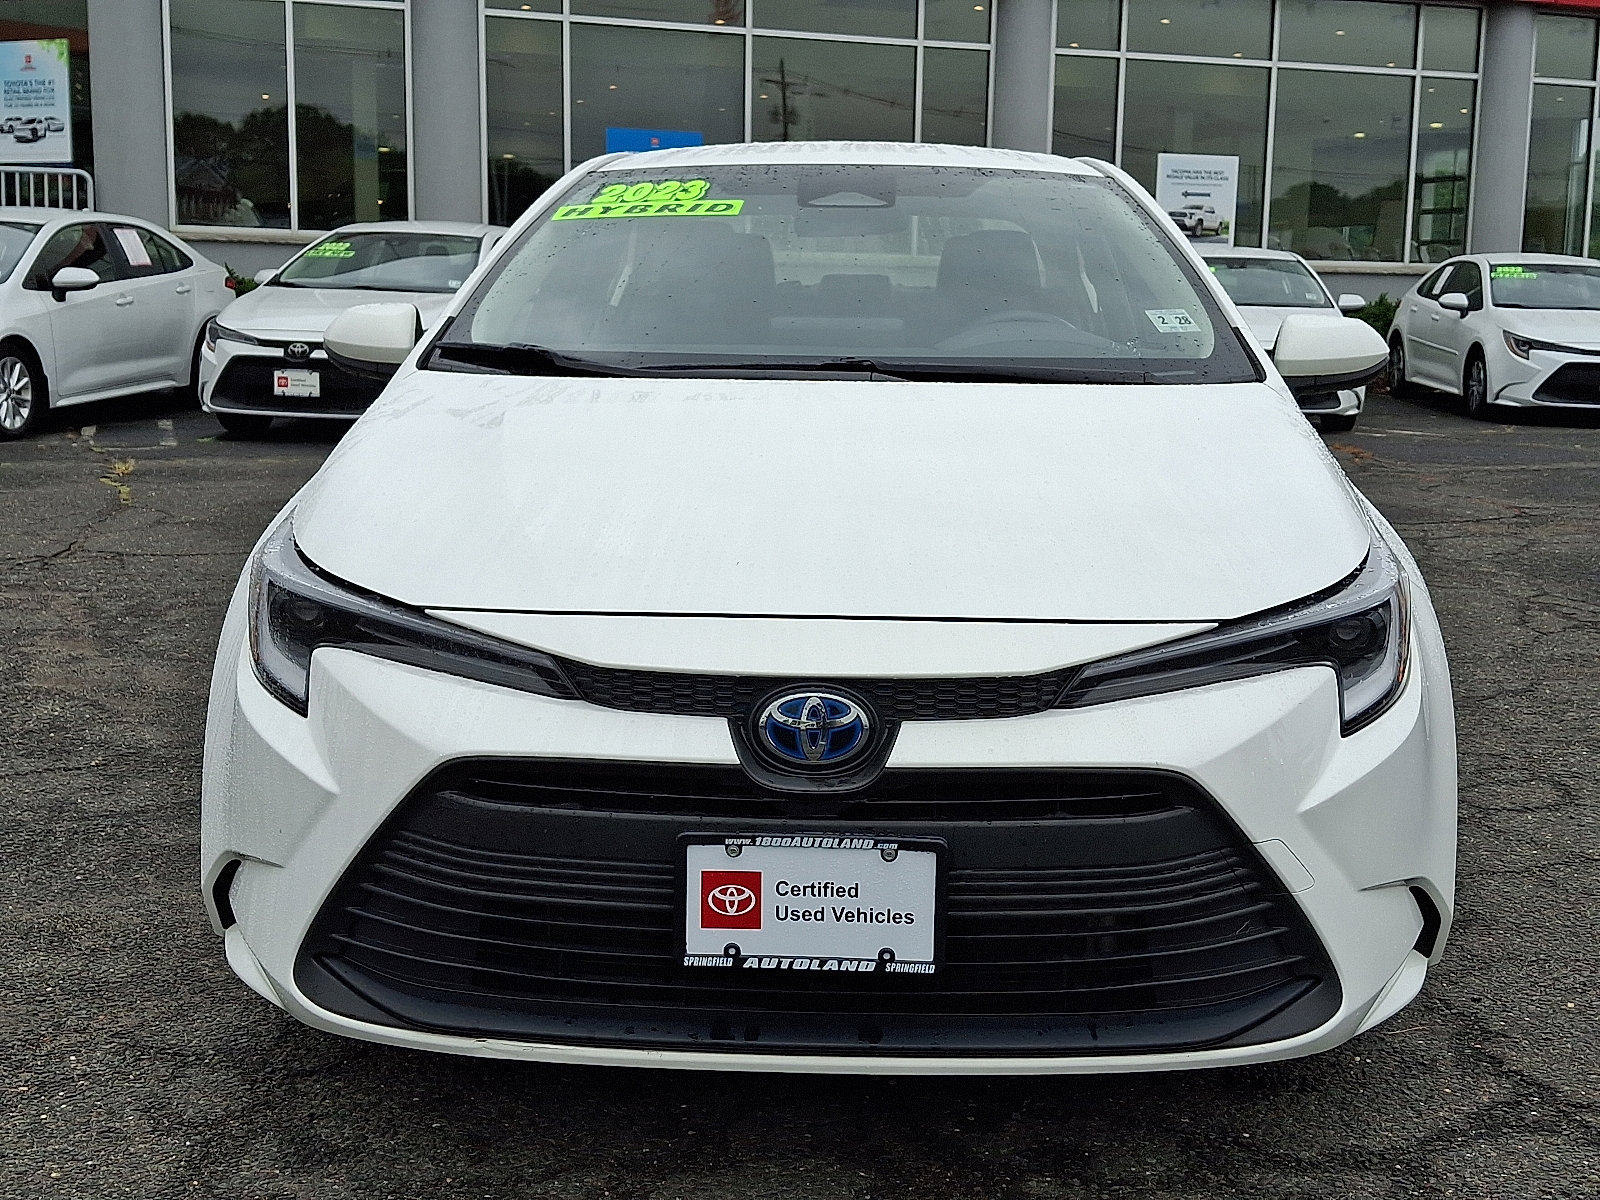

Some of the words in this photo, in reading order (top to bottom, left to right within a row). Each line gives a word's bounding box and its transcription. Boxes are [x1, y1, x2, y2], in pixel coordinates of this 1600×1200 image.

[592, 179, 711, 204] 2023
[561, 203, 735, 218] HYBRID
[1157, 315, 1169, 325] 2
[1174, 315, 1192, 325] 28
[774, 880, 860, 899] Certified
[774, 904, 826, 922] Used
[831, 906, 916, 925] Vehicles
[683, 956, 733, 967] SPRINGFIELD
[742, 957, 877, 972] AUTOLAND
[884, 962, 936, 974] SPRINGFIELD
